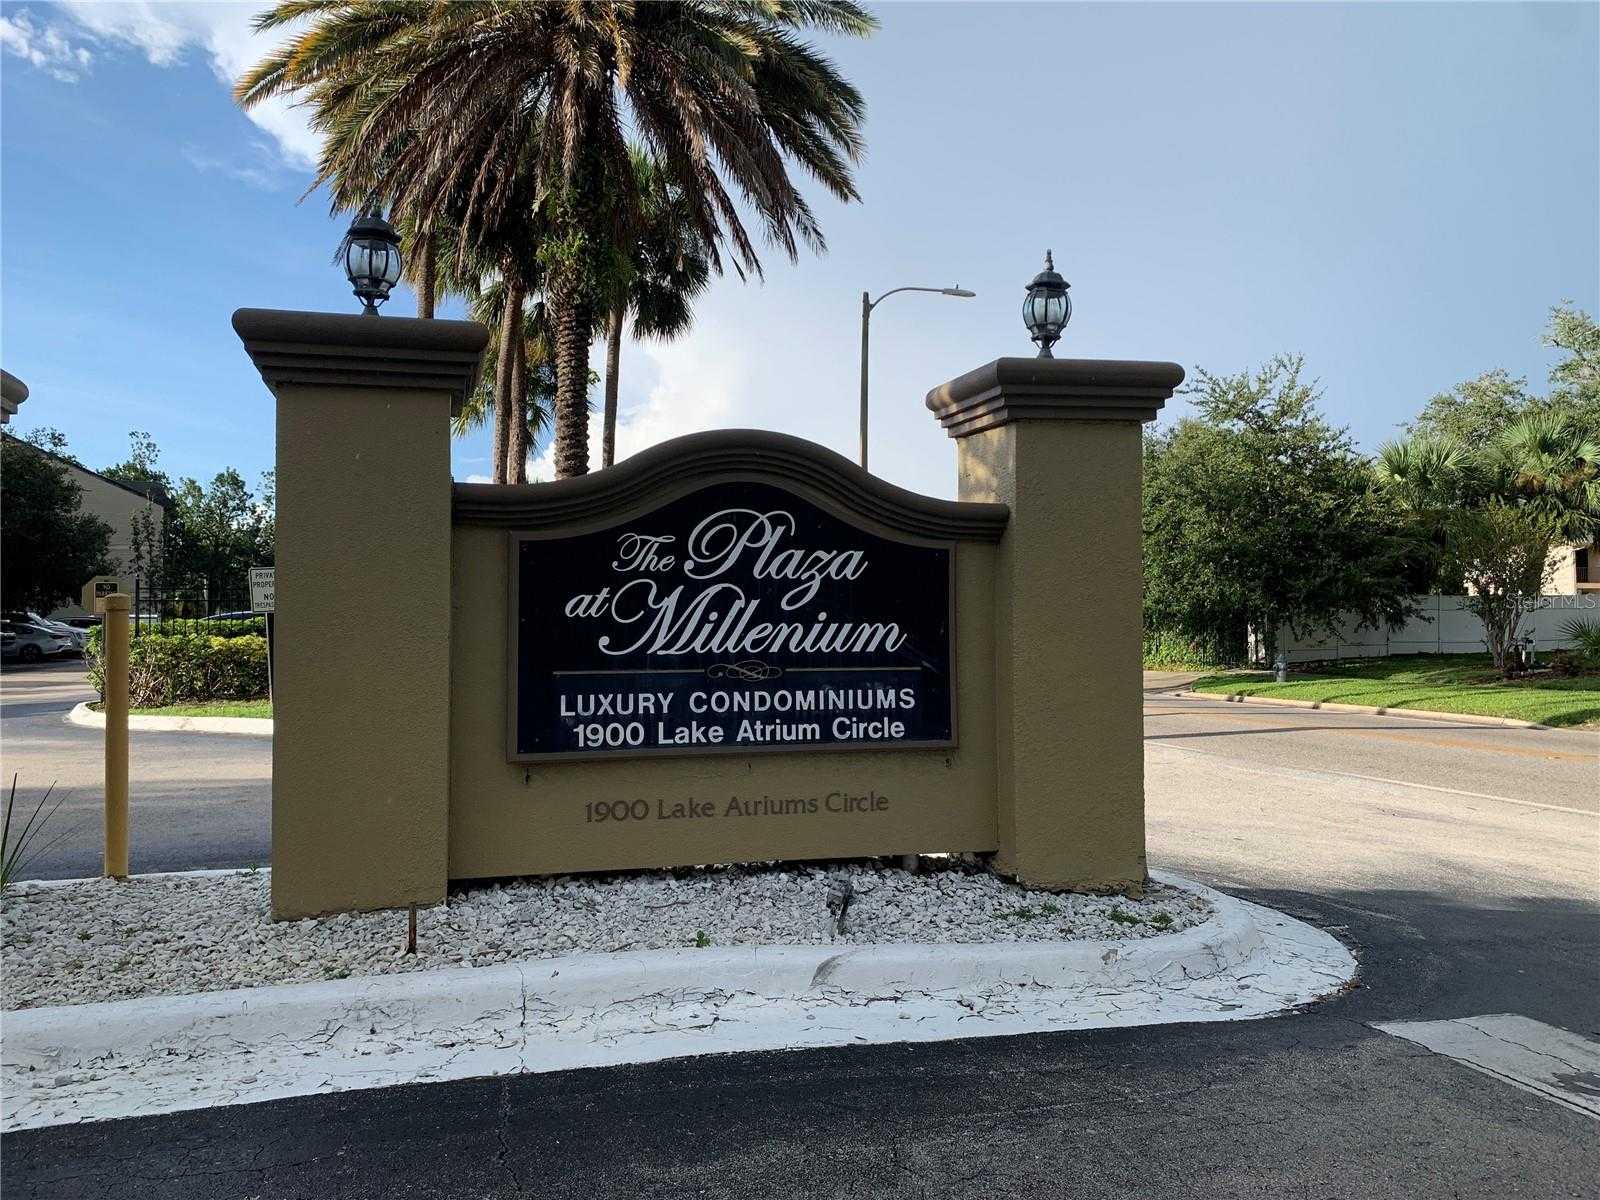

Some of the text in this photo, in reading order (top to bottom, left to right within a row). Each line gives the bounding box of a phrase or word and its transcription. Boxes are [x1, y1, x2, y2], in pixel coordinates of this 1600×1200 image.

[612, 508, 868, 611] The Plaza
[564, 578, 908, 656] at Millenium
[559, 687, 916, 717] LUXURY CONDOMINIUMS
[573, 716, 906, 748] 1900 Lake Atrium Circle
[586, 790, 889, 823] 1900 Lake Atriums Circle
